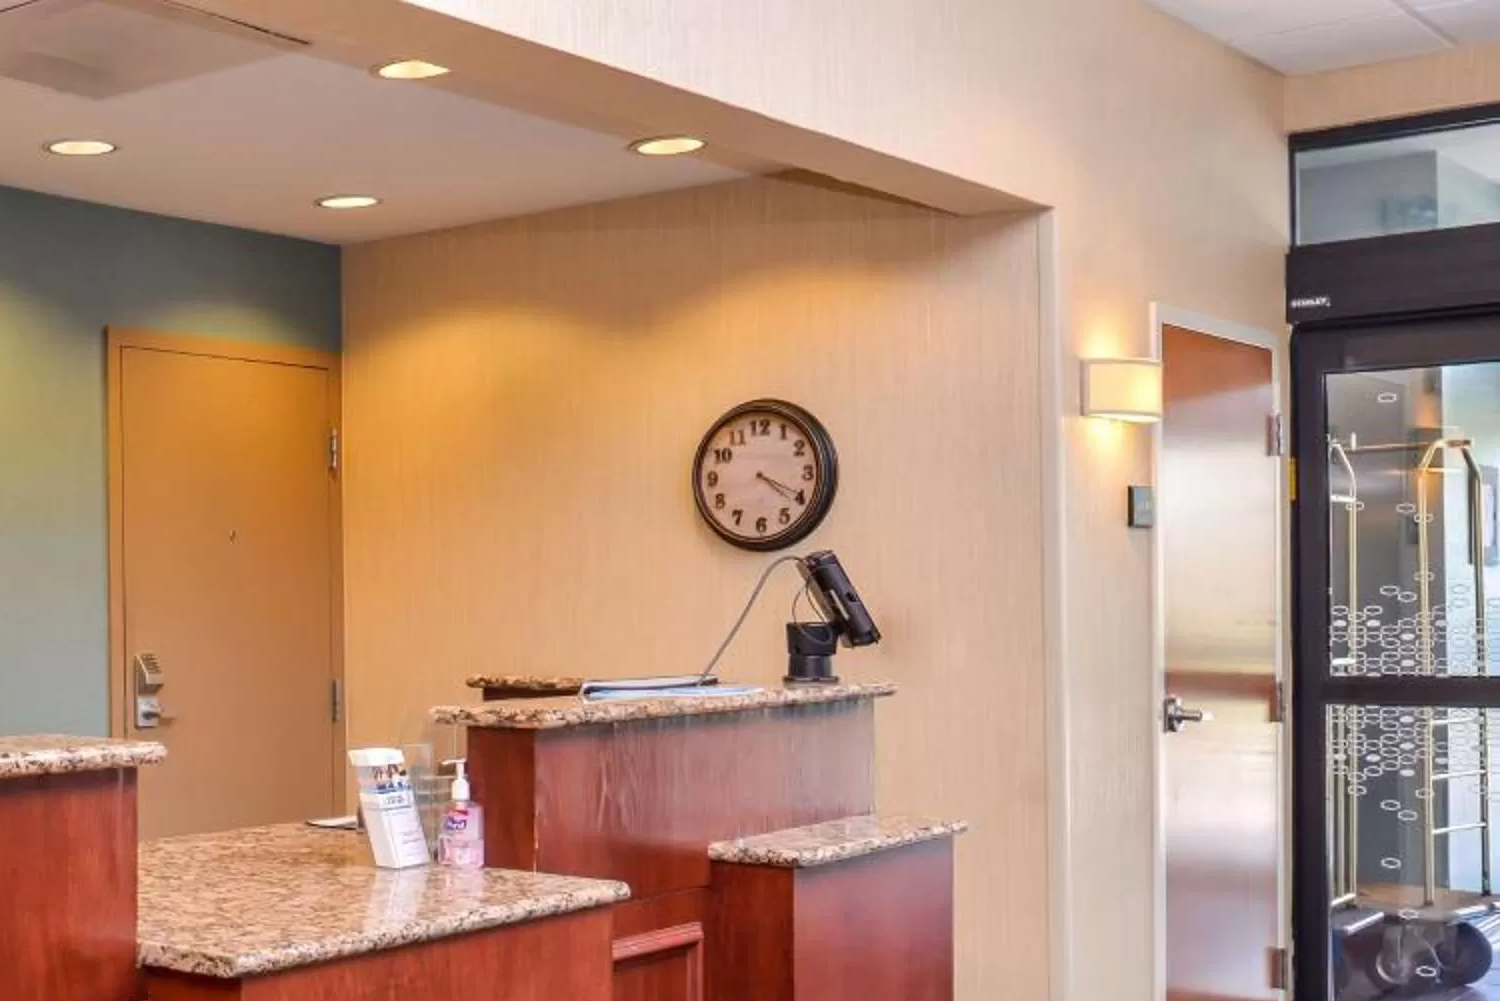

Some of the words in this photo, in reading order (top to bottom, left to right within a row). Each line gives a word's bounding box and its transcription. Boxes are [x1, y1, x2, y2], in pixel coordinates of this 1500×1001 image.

[749, 419, 771, 437] 12
[779, 424, 787, 440] 1
[729, 429, 747, 446] 11
[713, 448, 733, 464] 10
[793, 440, 805, 457] 2
[707, 470, 719, 487] 9
[802, 464, 814, 481] 3
[715, 493, 726, 510] 8
[794, 489, 805, 505] 4
[731, 509, 744, 526] 7
[779, 507, 791, 525] 5
[755, 517, 768, 533] 6
